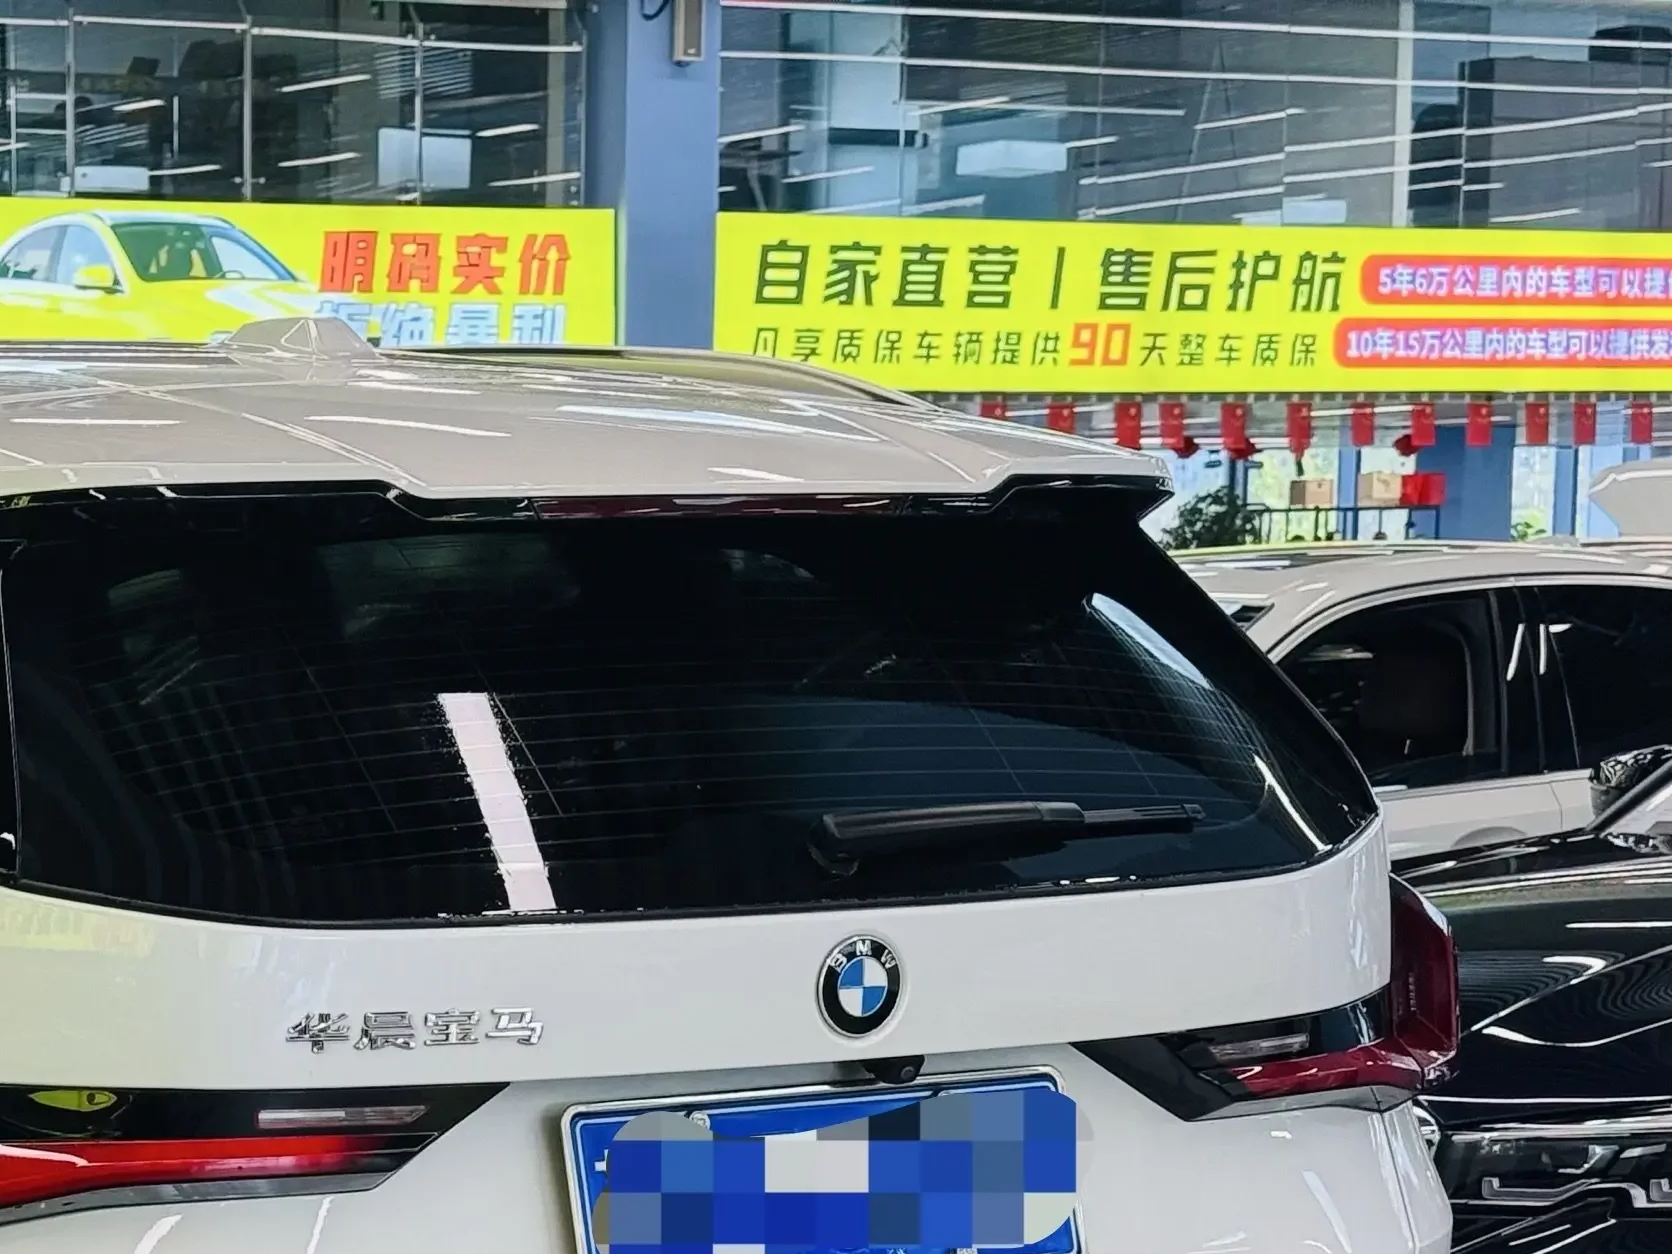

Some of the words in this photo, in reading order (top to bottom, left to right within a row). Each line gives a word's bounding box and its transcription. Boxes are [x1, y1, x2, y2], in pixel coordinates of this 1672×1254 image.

[318, 230, 572, 296] 明码实价
[754, 239, 1020, 309] 自家直营
[1097, 247, 1347, 312] 售后护航
[1377, 264, 1672, 299] 5年6万公里内的车型可以提
[1345, 327, 1672, 363] 10年15万公里内的车型可以提供发
[829, 939, 898, 974] BMW
[285, 1007, 545, 1054] 华晨宝马
